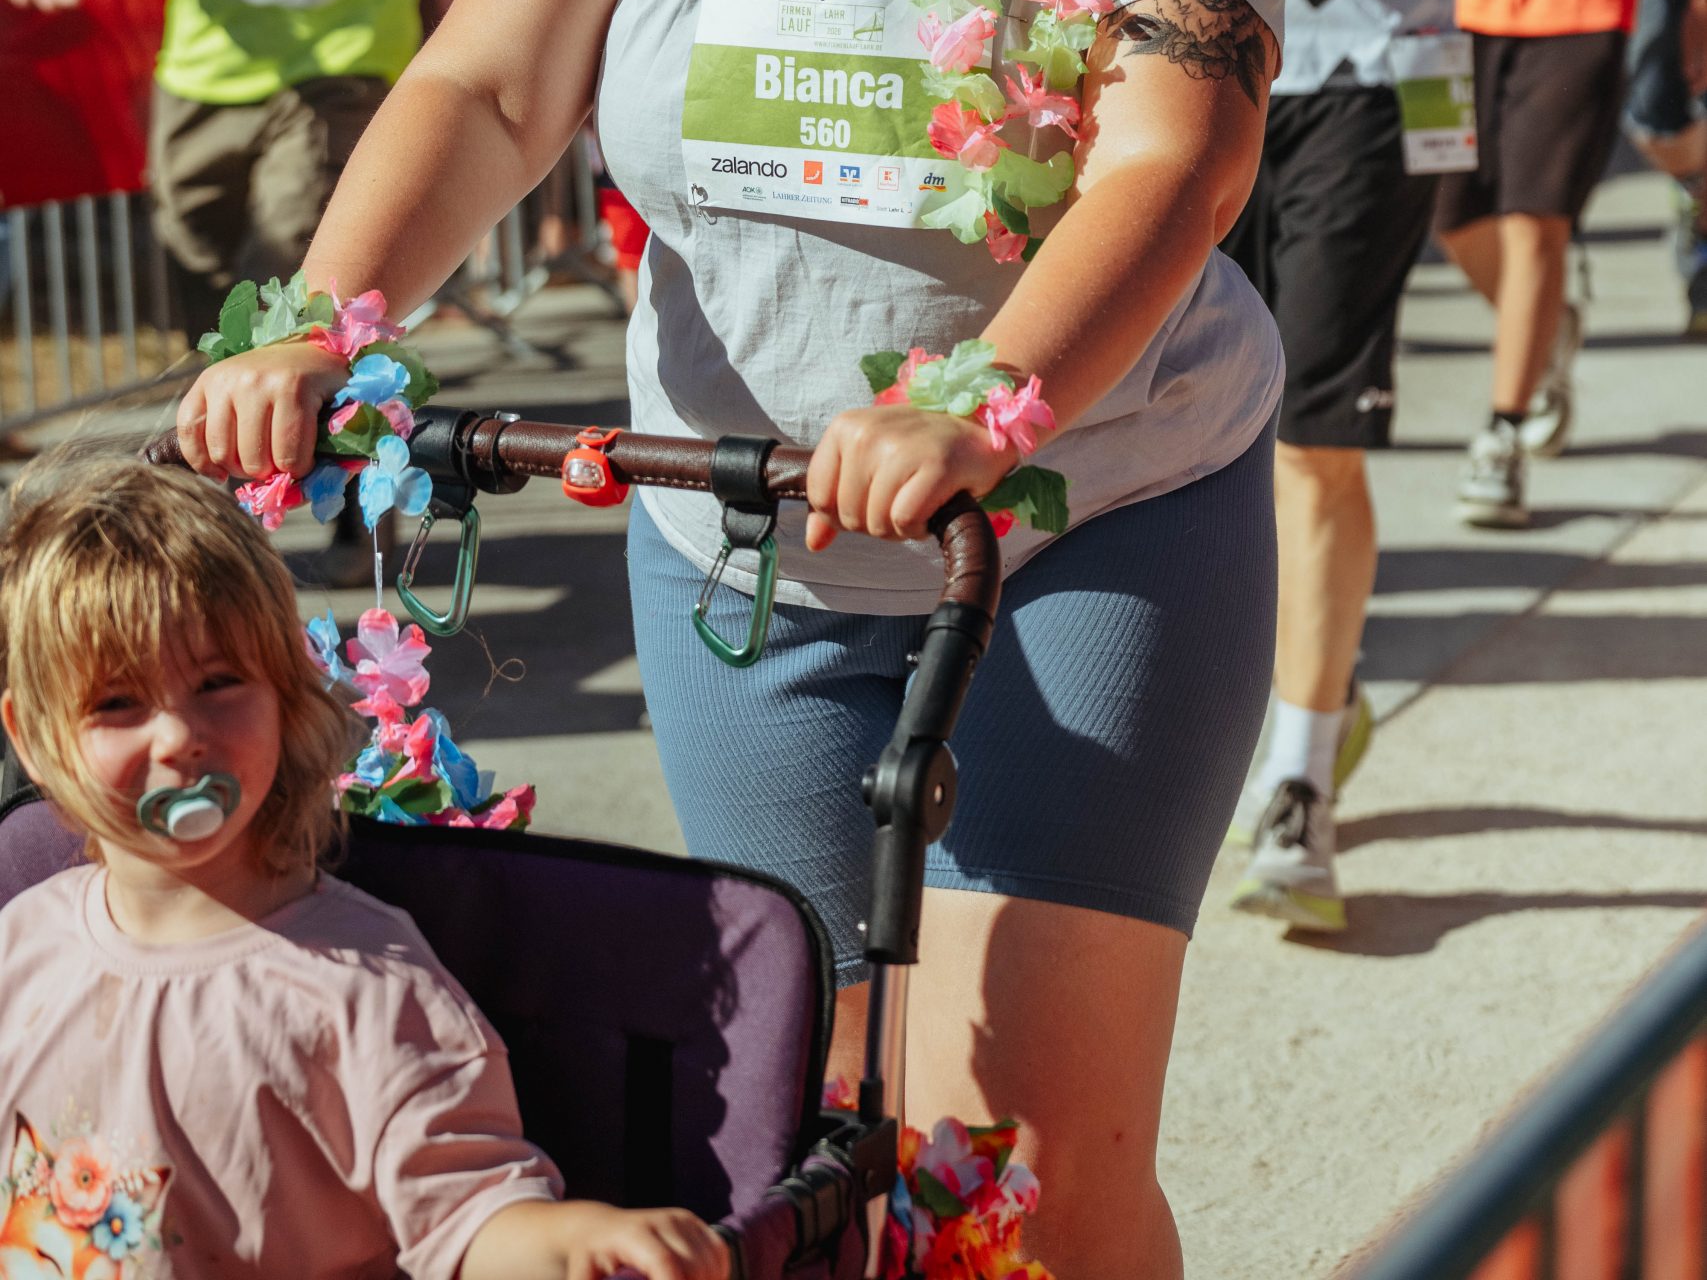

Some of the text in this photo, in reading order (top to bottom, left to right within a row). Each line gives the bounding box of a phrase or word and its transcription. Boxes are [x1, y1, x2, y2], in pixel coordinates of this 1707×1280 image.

[781, 5, 812, 16] FIRMEN
[824, 9, 846, 20] LAHR
[781, 17, 812, 32] LAUF
[755, 53, 904, 109] Bianca
[799, 116, 851, 149] 560
[710, 156, 788, 179] zalando
[923, 172, 945, 186] dm
